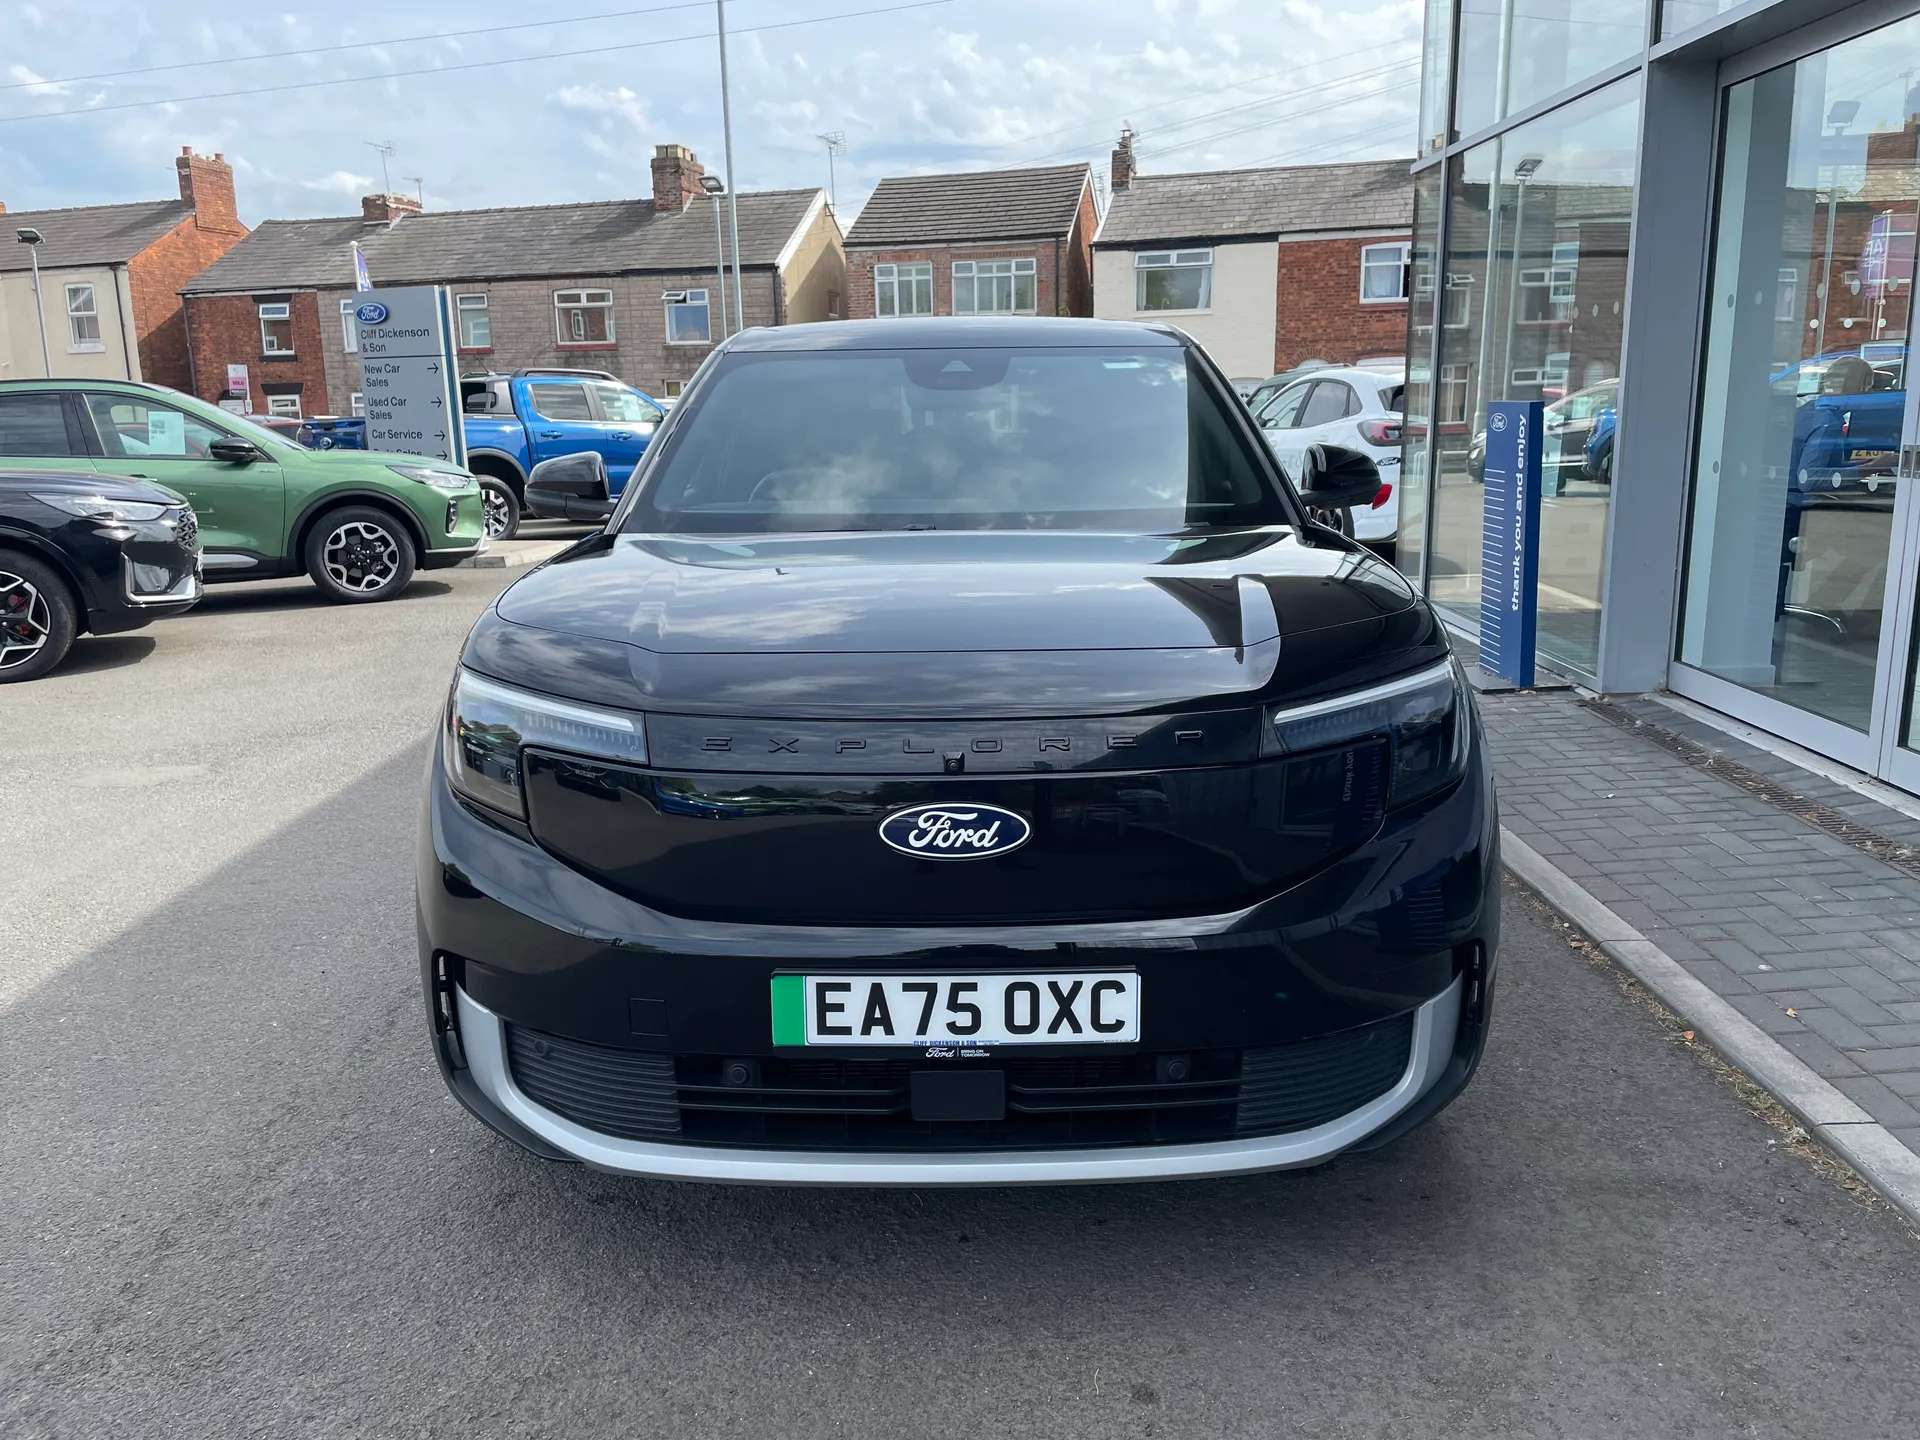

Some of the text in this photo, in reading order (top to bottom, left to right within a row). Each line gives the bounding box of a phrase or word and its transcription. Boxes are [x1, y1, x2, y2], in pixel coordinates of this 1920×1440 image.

[361, 306, 380, 320] Ford
[361, 328, 430, 340] Cliff Dickenson
[362, 342, 386, 353] & Son
[364, 363, 400, 375] New Car
[366, 377, 389, 388] Sales
[368, 396, 407, 407] Used Car
[369, 409, 393, 420] Sales
[372, 428, 423, 439] Car Service
[1517, 414, 1526, 469] enjoy
[1516, 473, 1524, 512] and
[1512, 554, 1521, 611] thank
[908, 811, 1001, 848] Ford
[815, 980, 1127, 1036] EA75 OXC
[925, 1047, 955, 1058] Ford
